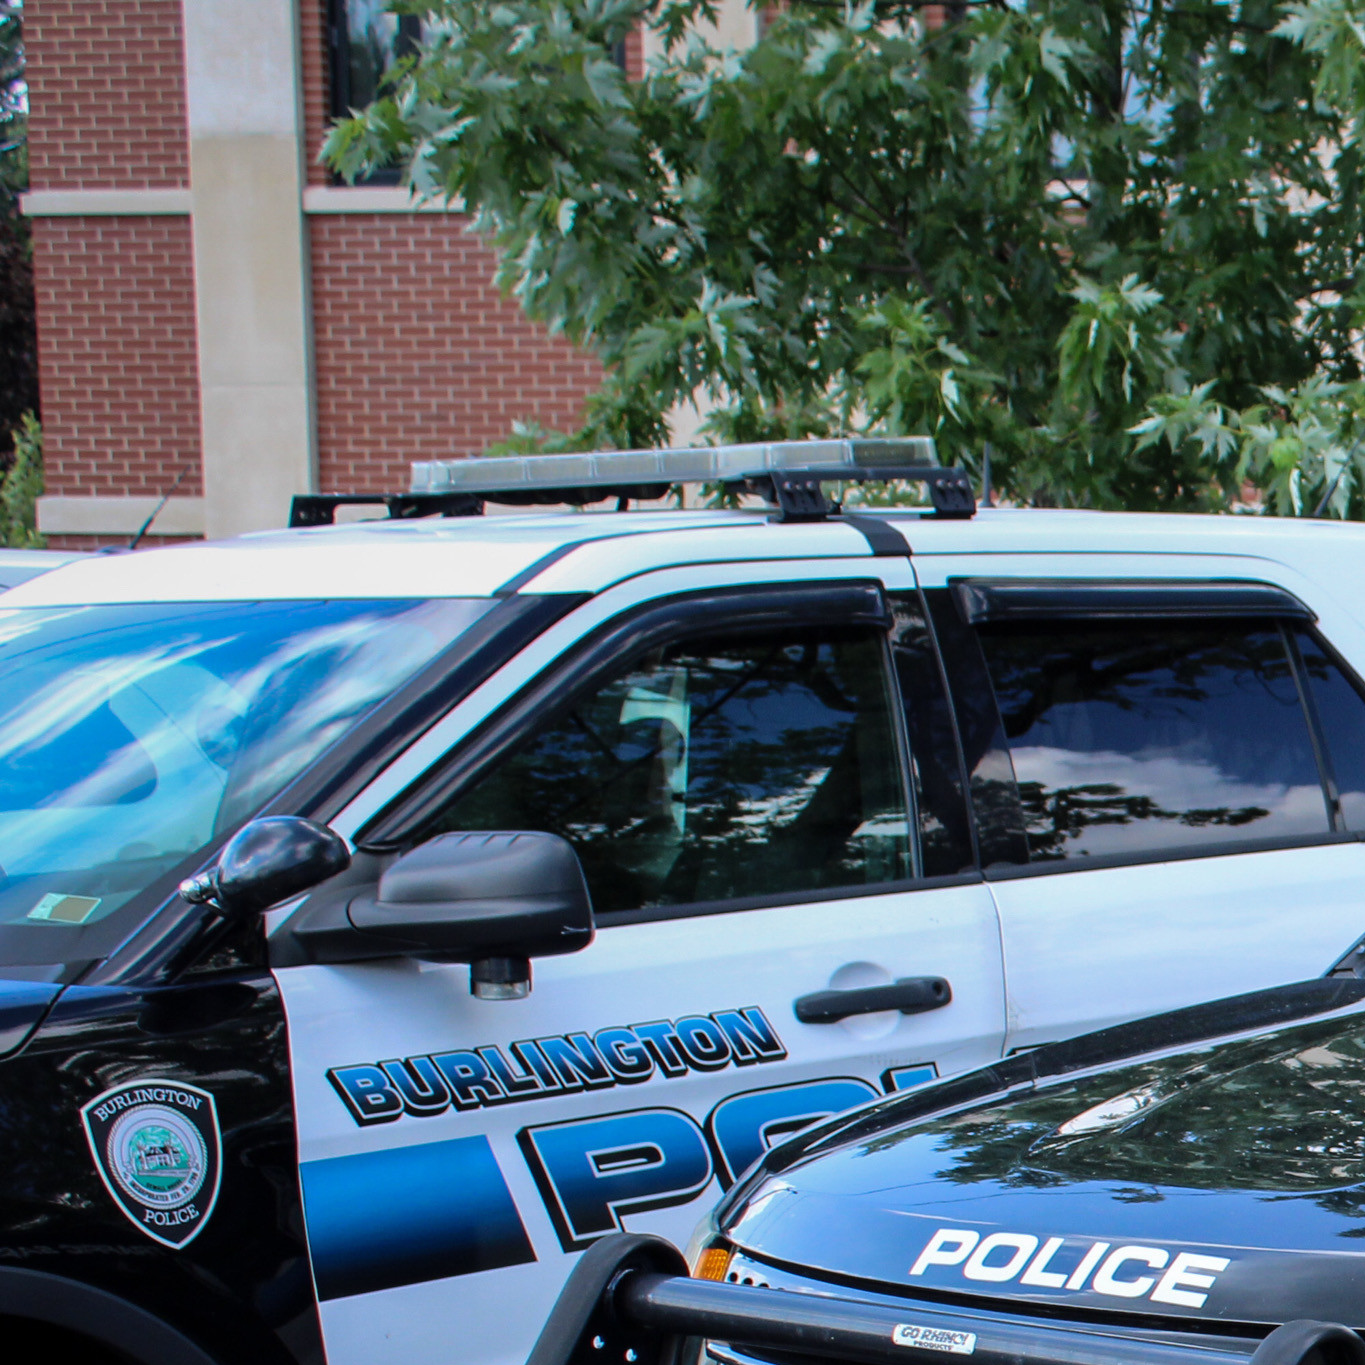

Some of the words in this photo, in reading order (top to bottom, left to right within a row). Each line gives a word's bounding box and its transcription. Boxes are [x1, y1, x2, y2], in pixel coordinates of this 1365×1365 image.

[326, 1006, 787, 1126] BURLINGTON
[94, 1088, 202, 1122] BURLINGTON
[143, 1204, 199, 1226] POLICE
[909, 1228, 1231, 1310] POLICE
[901, 1326, 920, 1339] GO
[913, 1340, 954, 1351] PRODUCTS
